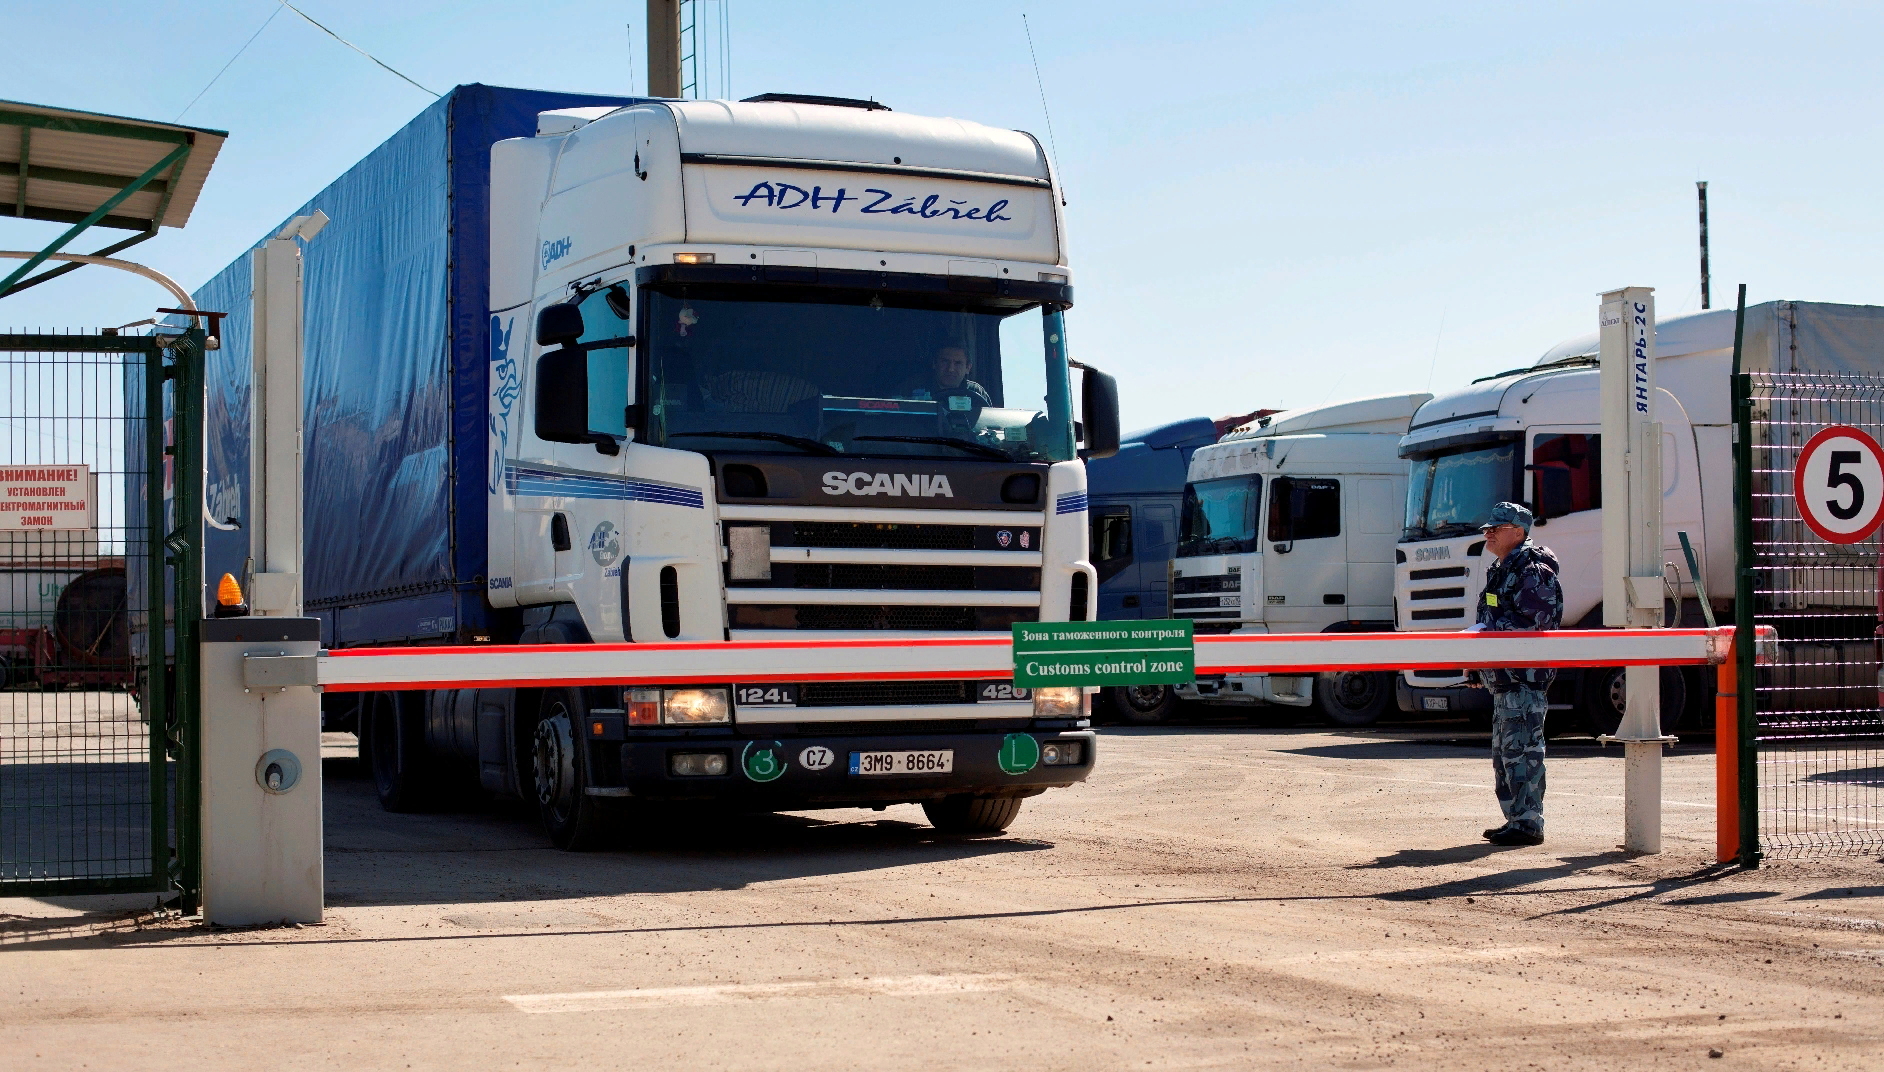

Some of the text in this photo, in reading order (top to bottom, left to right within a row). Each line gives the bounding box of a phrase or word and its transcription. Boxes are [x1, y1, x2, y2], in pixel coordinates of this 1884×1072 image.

[733, 181, 1011, 222] ADH Zábřeh
[1634, 302, 1648, 414] ЯНТАРЬ-2С
[7, 487, 66, 497] УСТАНОВЛЕН
[821, 471, 954, 498] SCANIA
[1826, 451, 1865, 520] 5
[0, 500, 86, 512] ЕКТРОМАГНИТНЫЙ
[1415, 546, 1451, 562] SCANIA
[490, 576, 513, 589] SCANIA
[1222, 581, 1241, 589] DAF
[1021, 630, 1185, 641] Зона таможенного контроля
[1026, 659, 1184, 676] Customs control zone
[806, 750, 827, 766] CZ
[1011, 739, 1027, 767] L
[863, 753, 945, 772] 3M9 8664
